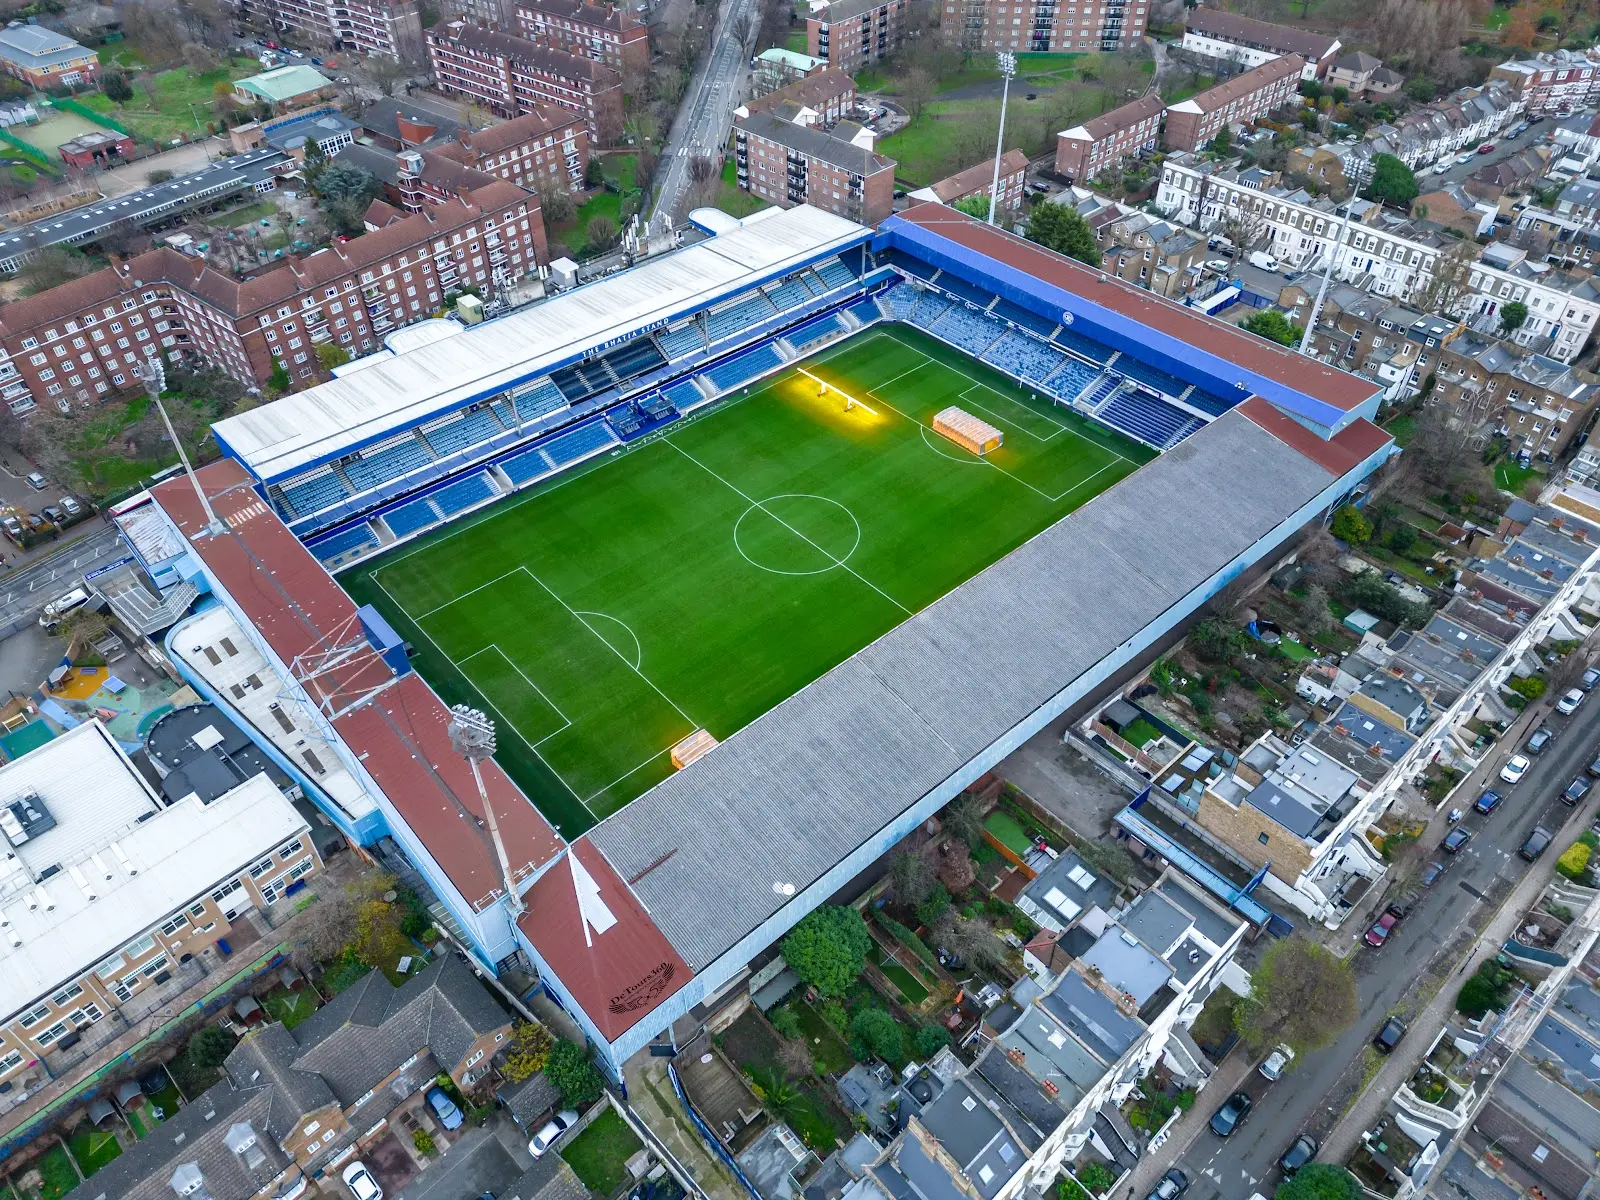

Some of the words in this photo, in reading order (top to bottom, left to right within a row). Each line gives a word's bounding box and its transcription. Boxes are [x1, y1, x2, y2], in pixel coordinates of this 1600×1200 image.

[583, 347, 599, 357] THE
[604, 331, 637, 348] BHATIA
[642, 318, 669, 333] STAND
